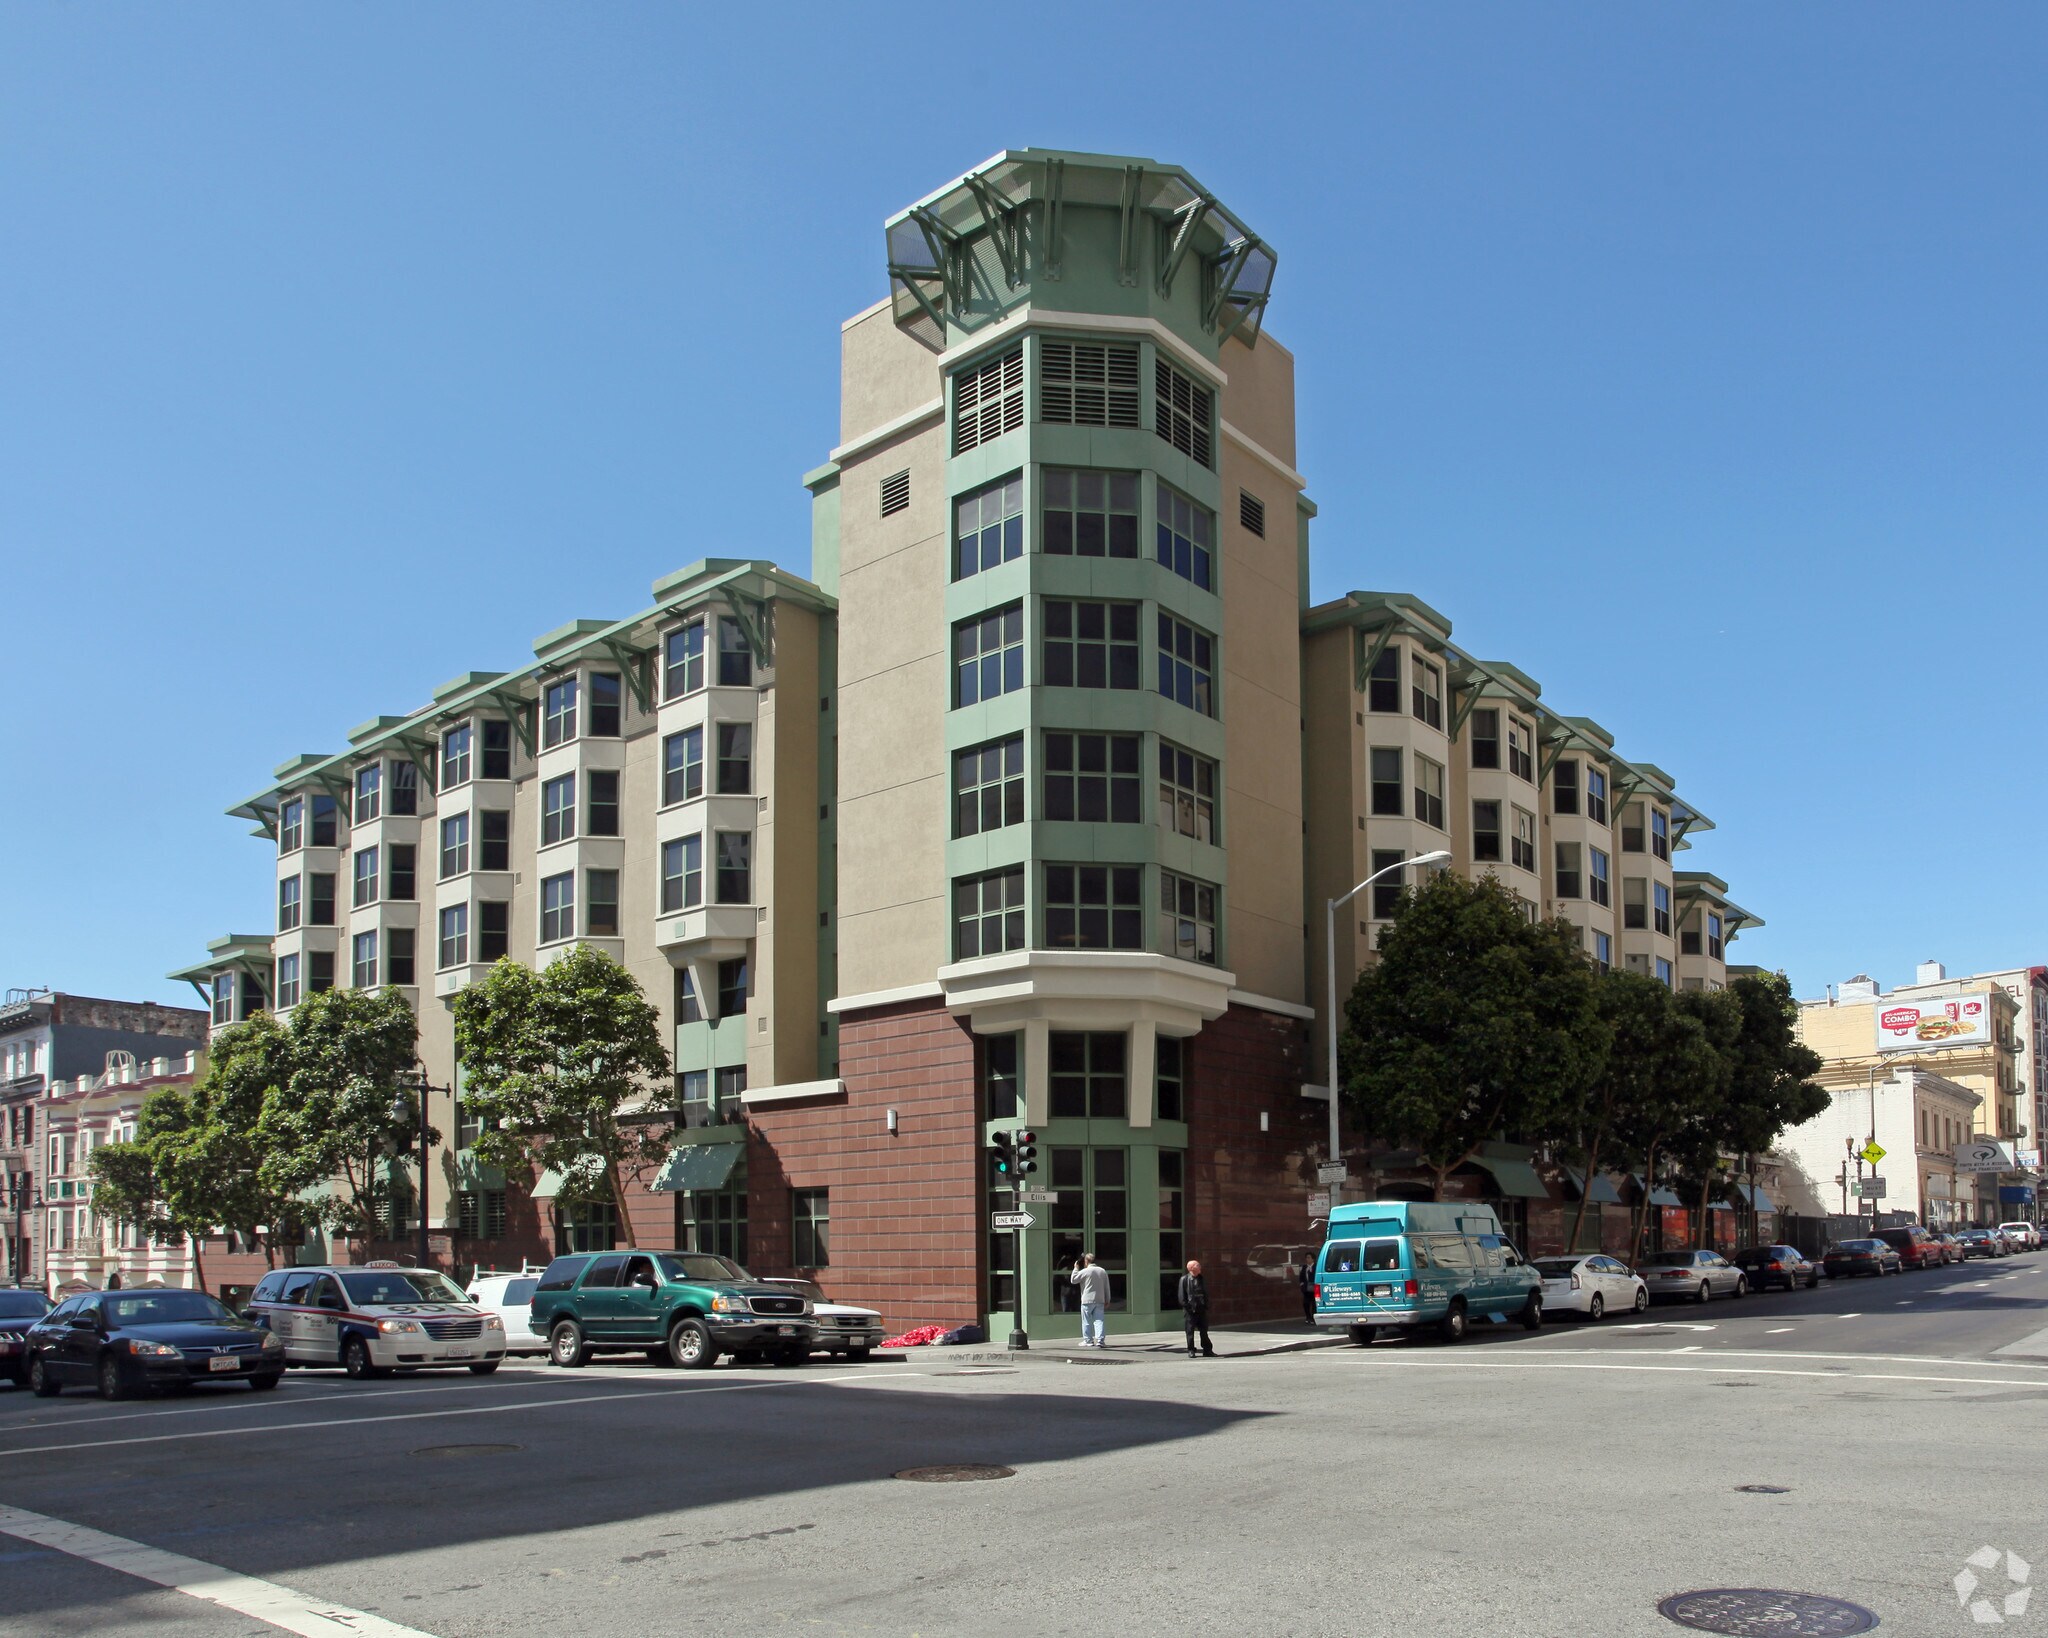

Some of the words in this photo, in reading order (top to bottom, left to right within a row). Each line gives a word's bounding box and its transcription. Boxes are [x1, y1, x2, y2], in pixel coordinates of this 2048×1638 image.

[1884, 1015, 1917, 1023] COMBO
[1030, 1193, 1047, 1201] Ellis
[370, 1261, 398, 1269] LUXOR
